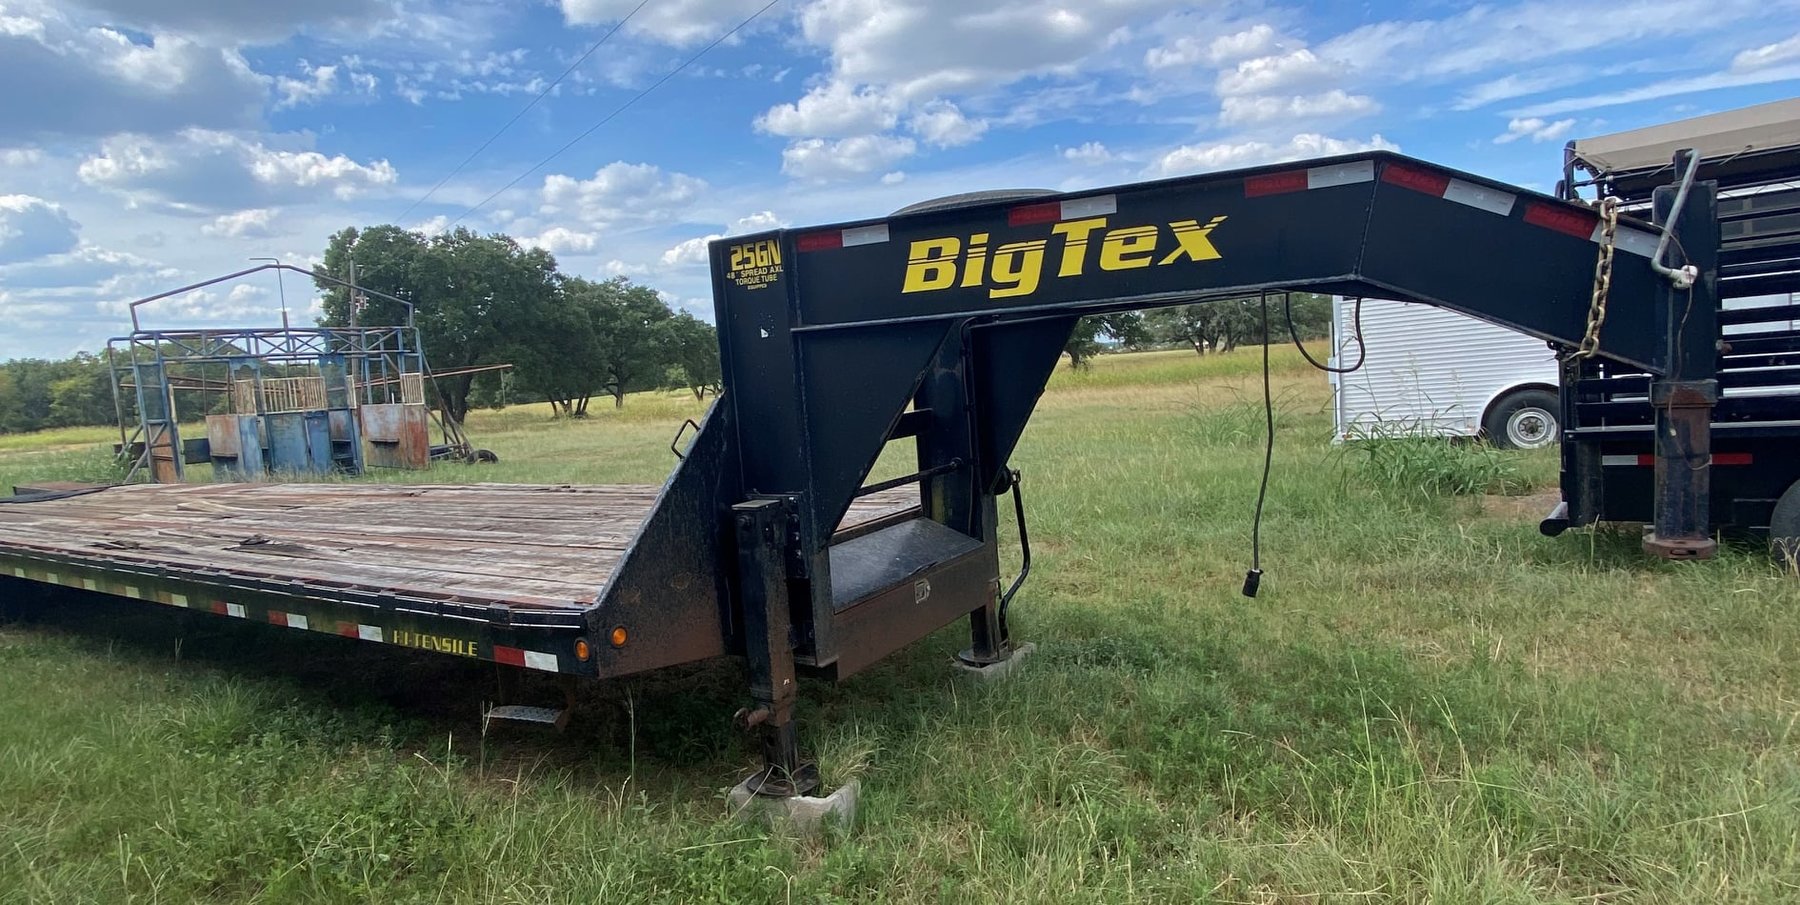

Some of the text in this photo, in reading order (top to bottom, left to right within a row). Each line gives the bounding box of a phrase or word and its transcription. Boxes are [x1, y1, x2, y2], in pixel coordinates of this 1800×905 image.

[730, 239, 781, 271] 25GN
[740, 267, 768, 278] SPREAD
[769, 265, 784, 273] AXL
[735, 274, 778, 285] TORQUE TUBE
